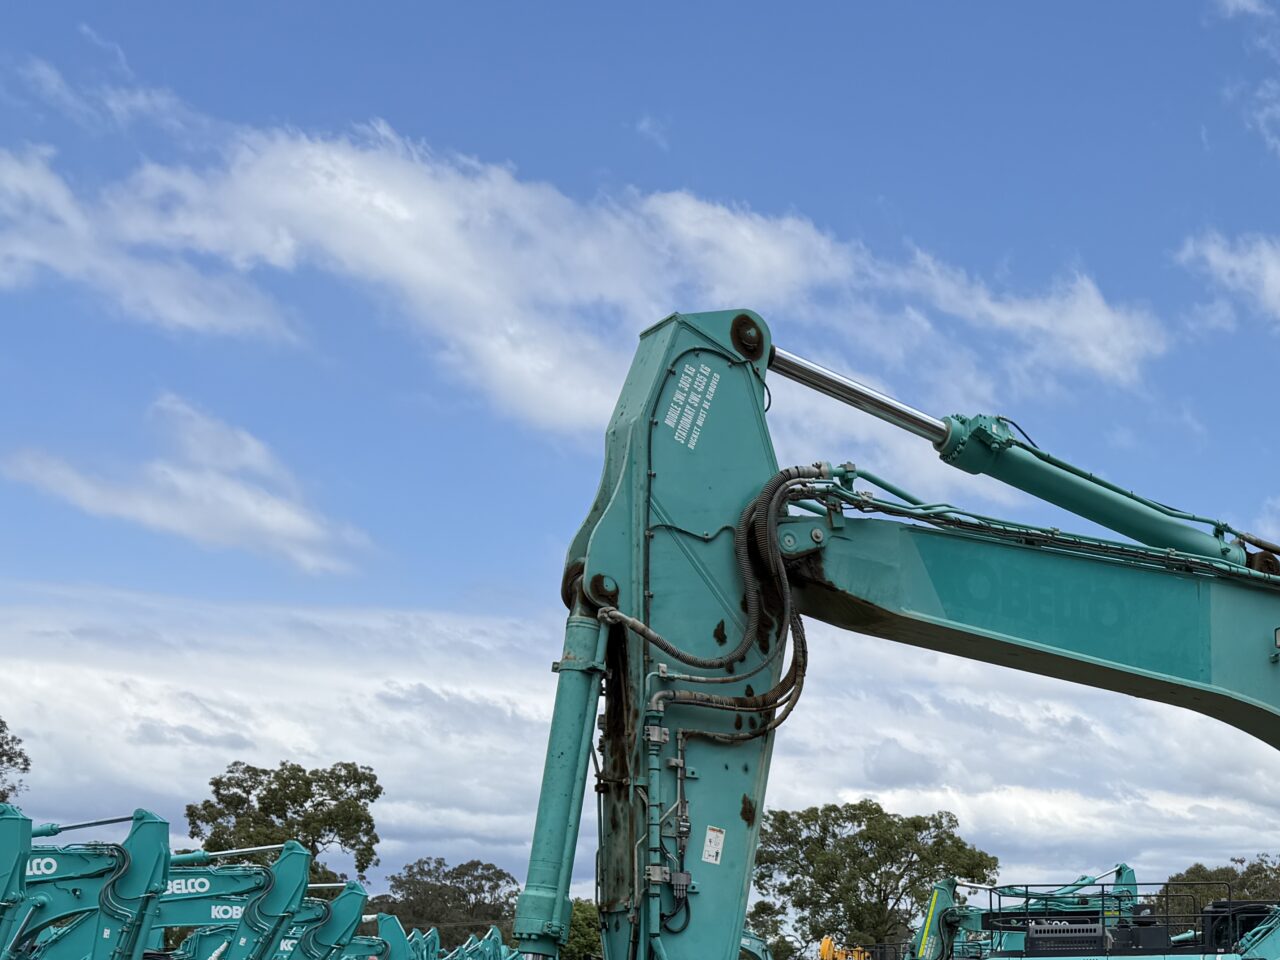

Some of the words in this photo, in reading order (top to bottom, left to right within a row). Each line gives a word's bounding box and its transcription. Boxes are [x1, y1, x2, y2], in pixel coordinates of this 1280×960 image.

[664, 402, 682, 428] MOBILE
[673, 389, 687, 405] SWL
[683, 364, 696, 376] KG
[705, 372, 720, 401] REMOVED
[674, 404, 696, 444] STATIONARY
[688, 391, 702, 407] SWL
[699, 364, 711, 376] KG
[702, 400, 711, 410] BE
[696, 408, 708, 427] MUST
[687, 426, 701, 450] BUCKET
[211, 905, 245, 919] KOB
